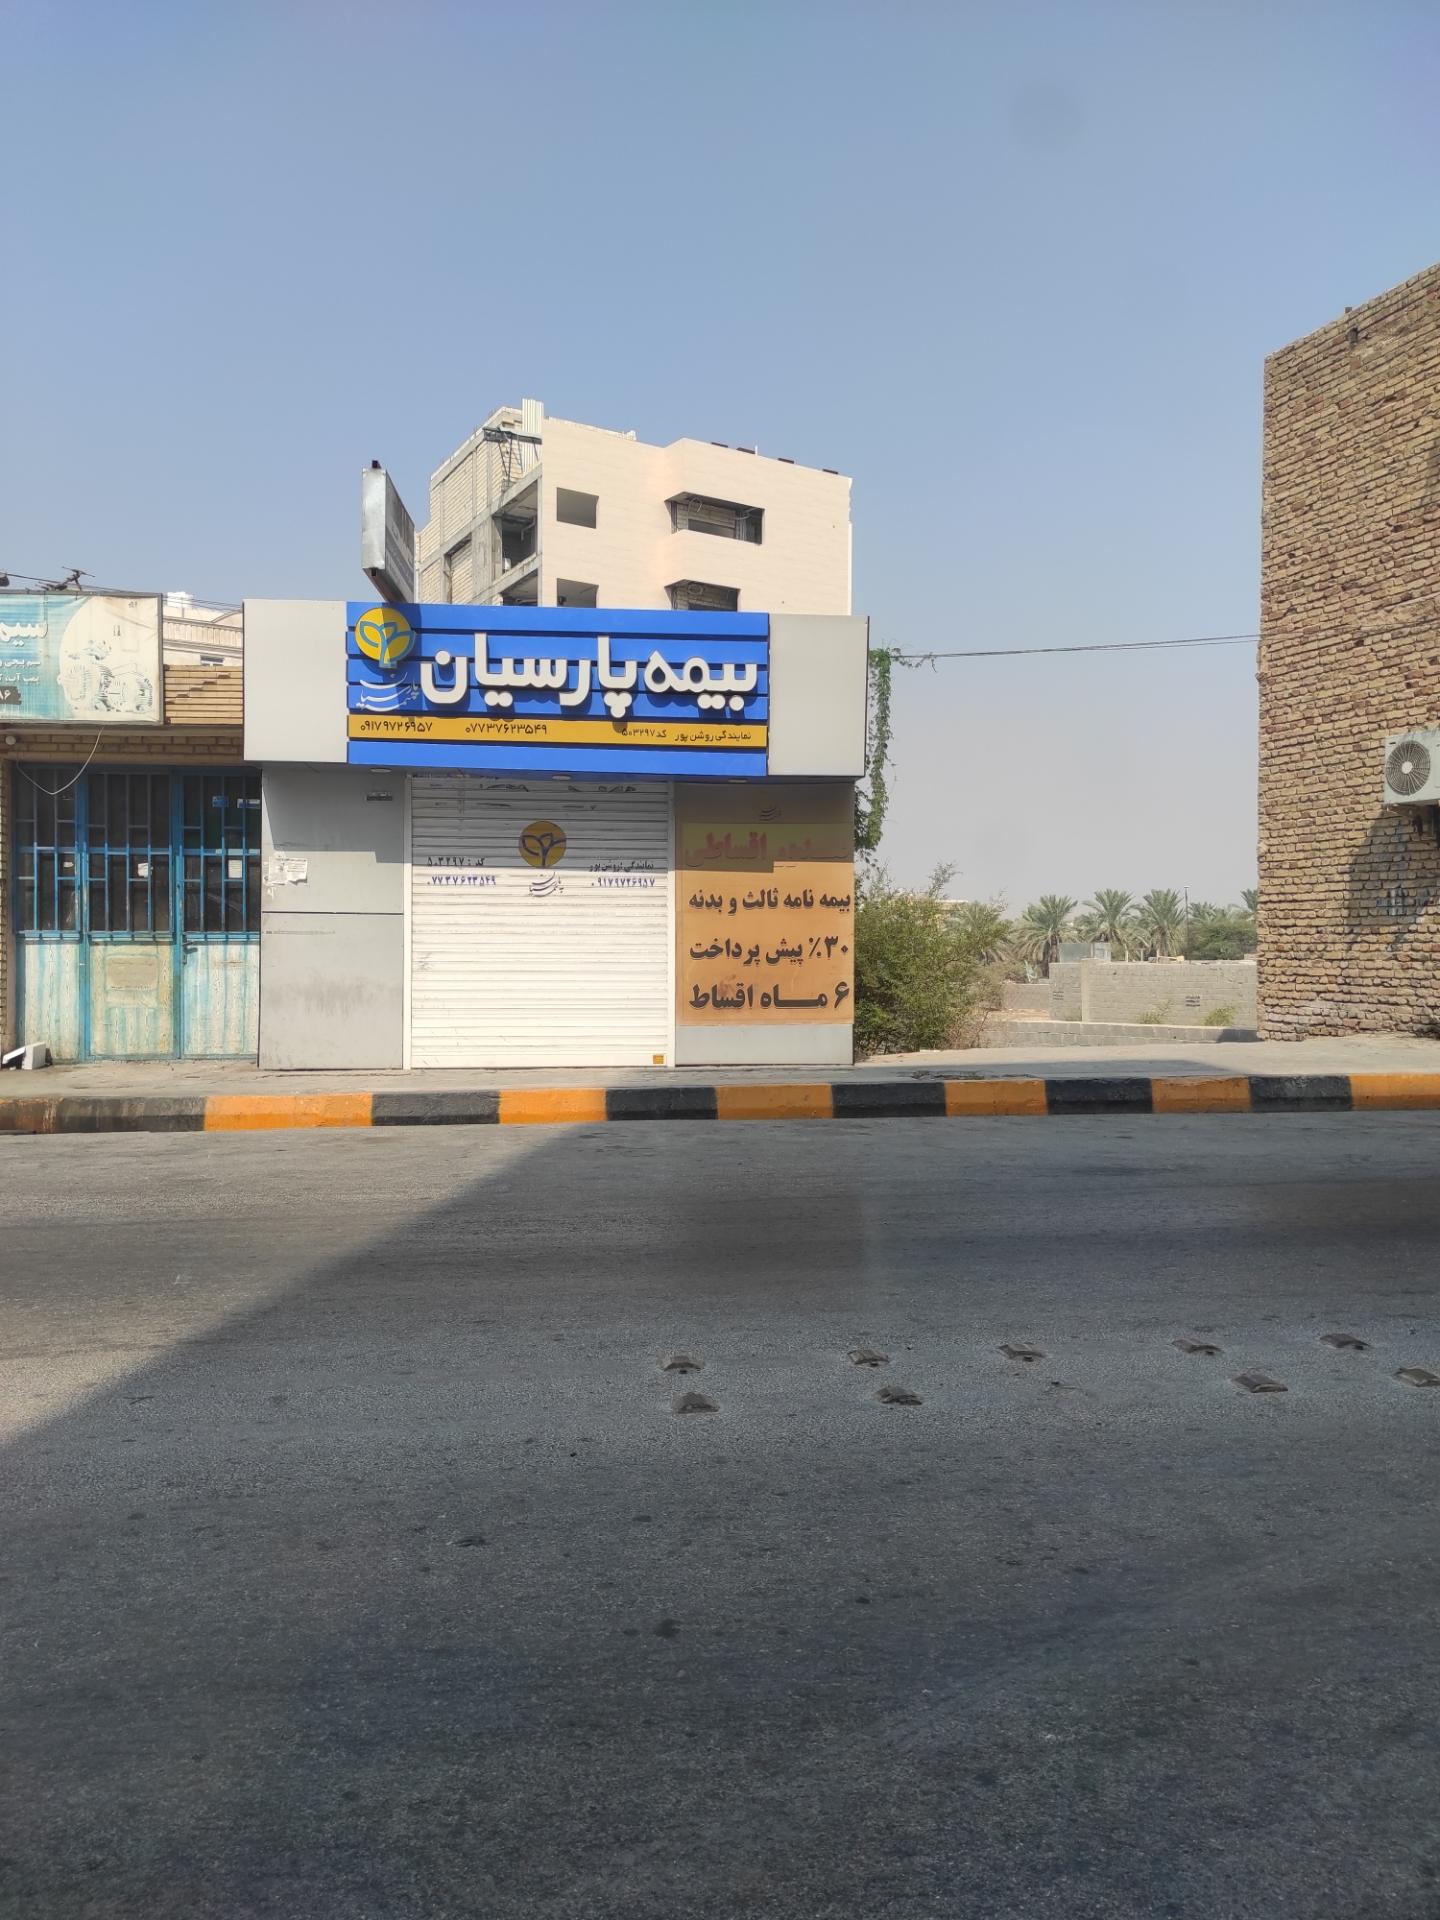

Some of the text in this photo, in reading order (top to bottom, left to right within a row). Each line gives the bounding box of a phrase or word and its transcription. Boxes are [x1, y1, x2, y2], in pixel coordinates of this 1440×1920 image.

[421, 632, 757, 718] بیمه پارسیان
[360, 719, 433, 733] ۰۹۱۷۹۷۲۶۹۵۷
[465, 722, 547, 735] ۰۷۷۳۷۶۲۳۵۴۹
[674, 729, 752, 743] نمایندگی روشن پور
[688, 886, 851, 916] بیمه نامه ثالث و بدنه
[766, 937, 804, 966] پیش
[688, 982, 753, 1010] اقساط
[834, 980, 850, 1010] ۶
